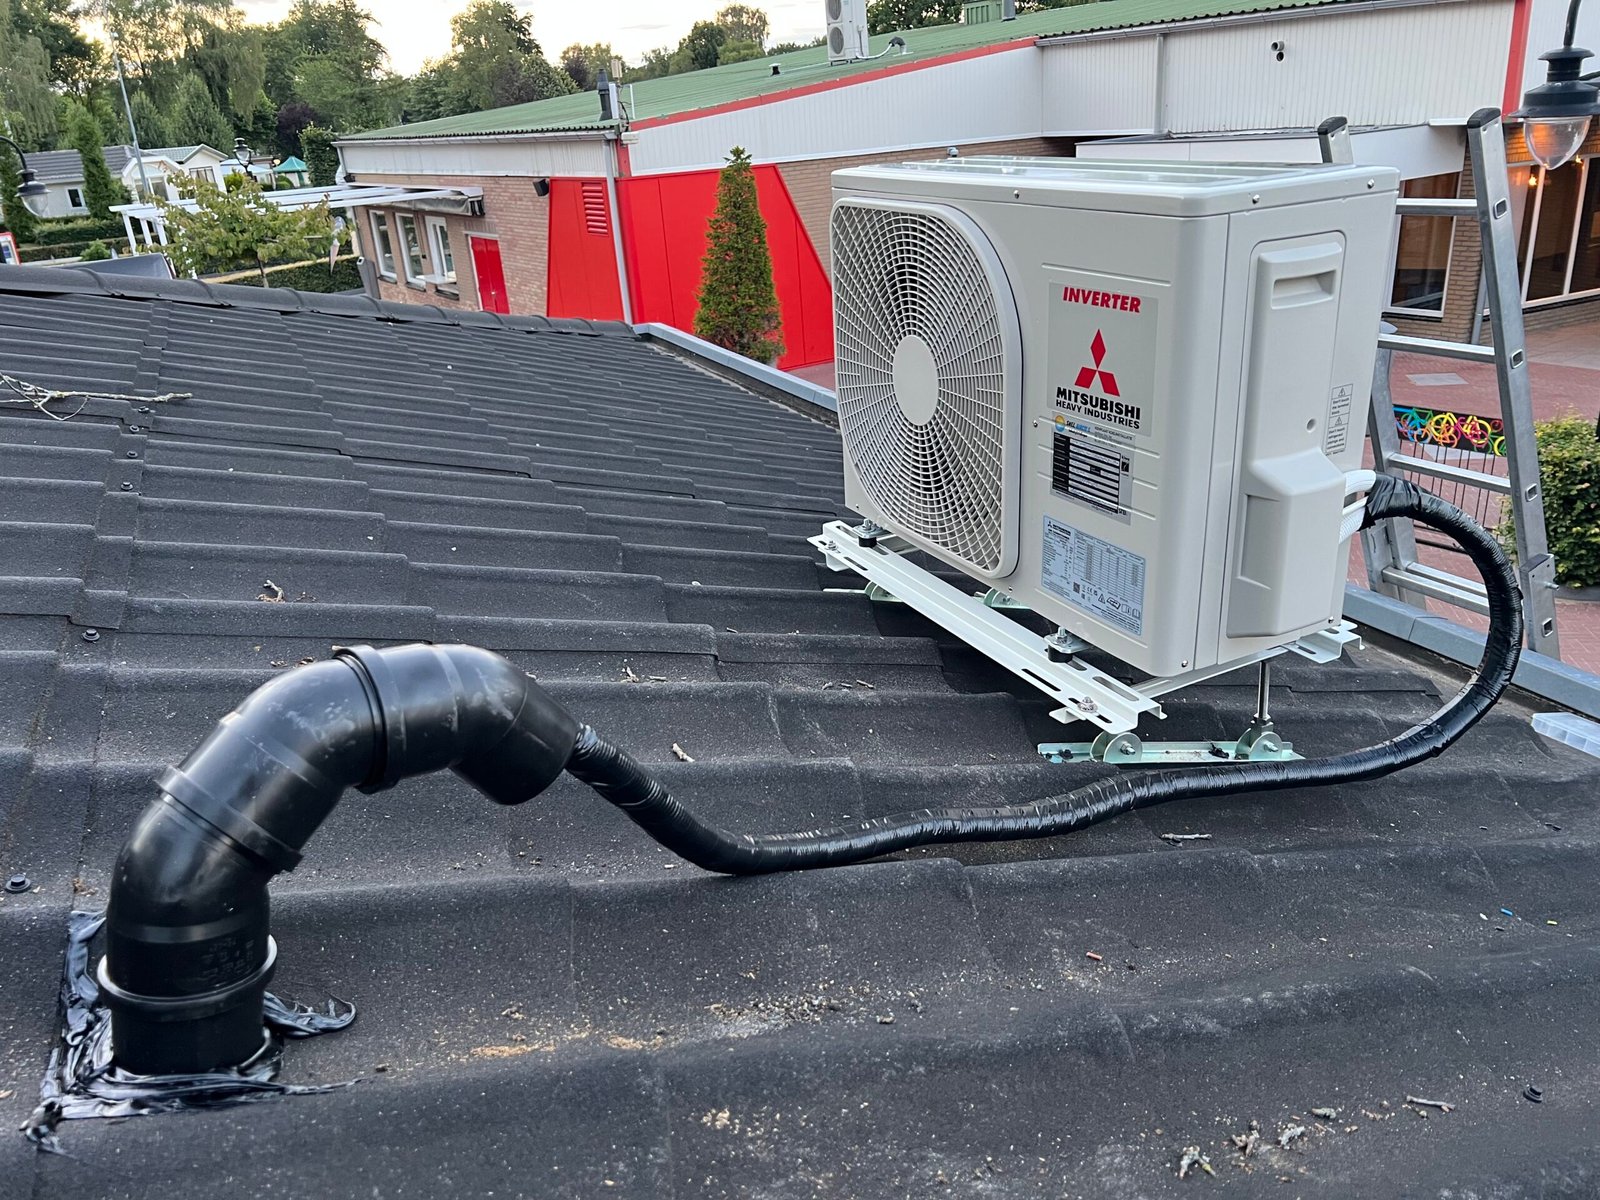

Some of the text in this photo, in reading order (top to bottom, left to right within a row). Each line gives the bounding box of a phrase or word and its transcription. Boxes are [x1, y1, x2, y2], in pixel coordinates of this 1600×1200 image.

[1062, 286, 1141, 313] INVERTER
[1056, 386, 1141, 420] MITSUBISHI
[1056, 399, 1083, 413] HEAVY
[1084, 406, 1140, 429] INDUSTRIES
